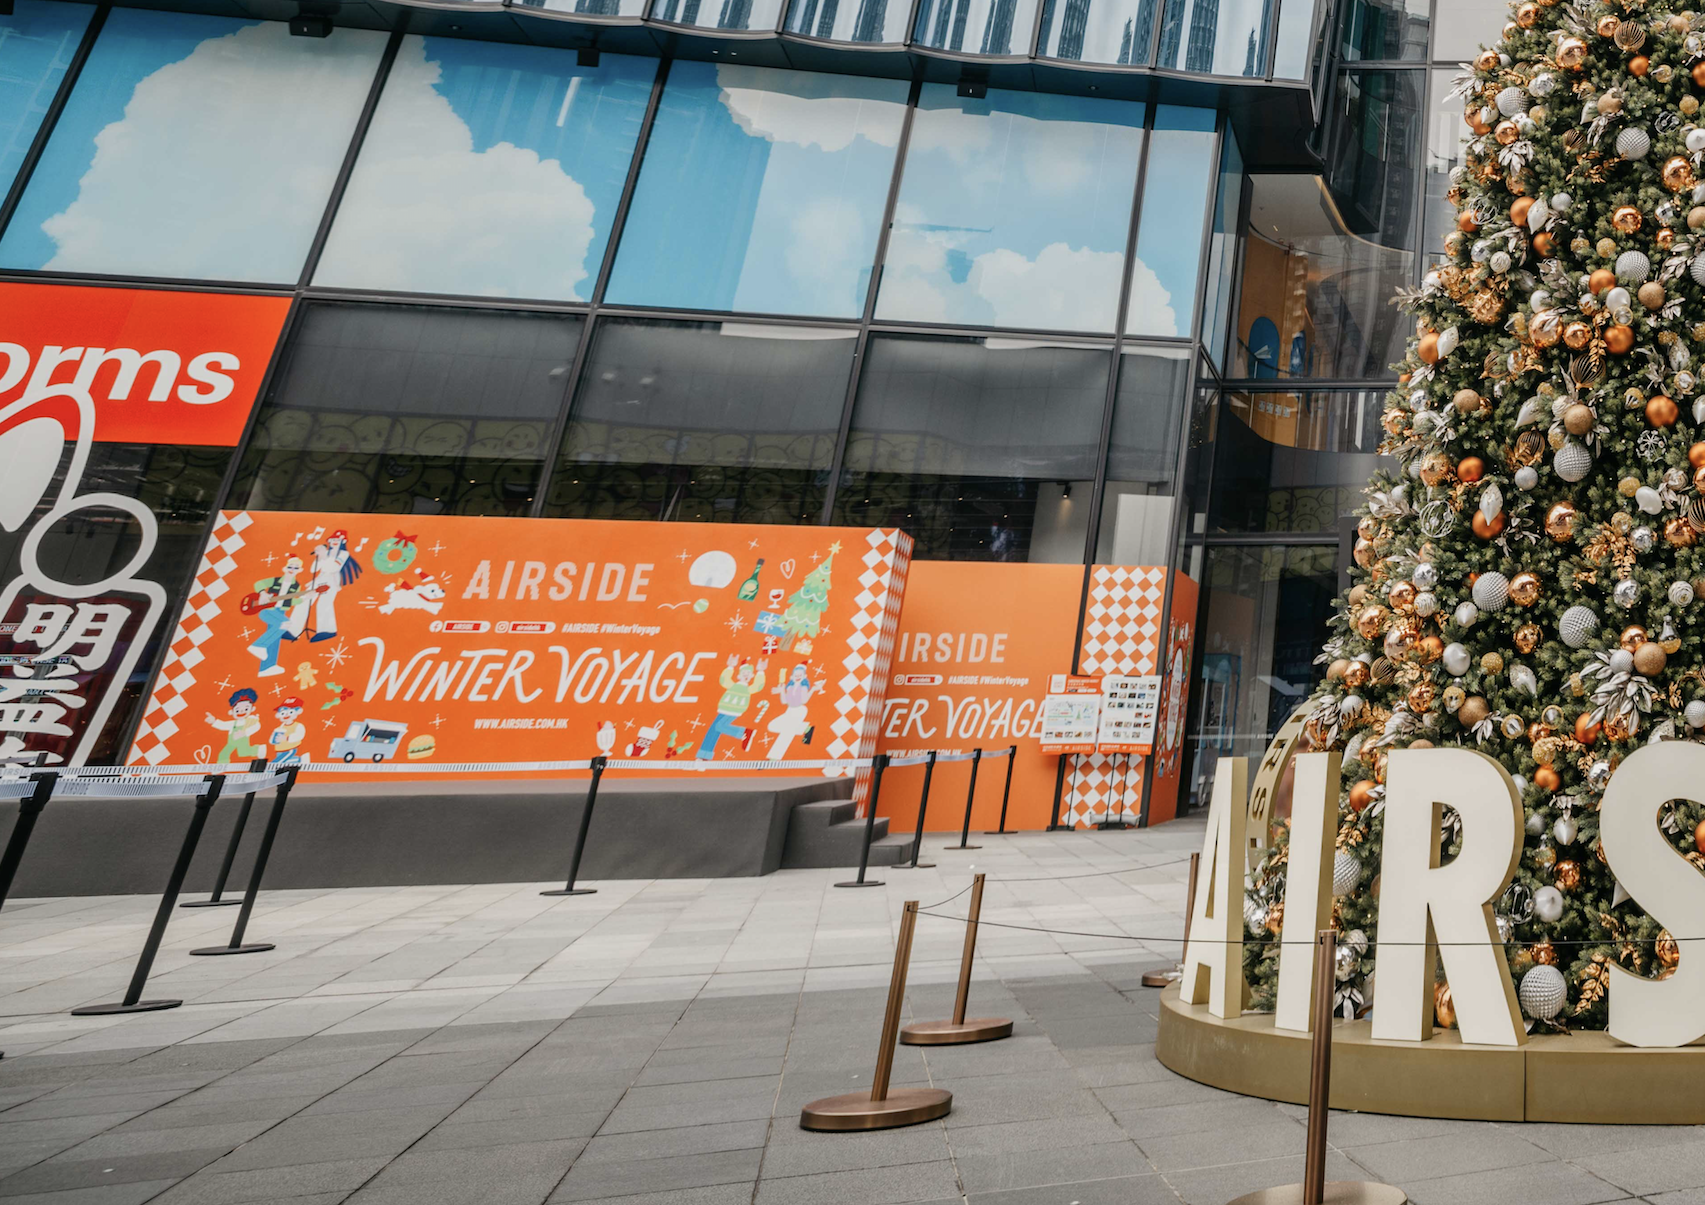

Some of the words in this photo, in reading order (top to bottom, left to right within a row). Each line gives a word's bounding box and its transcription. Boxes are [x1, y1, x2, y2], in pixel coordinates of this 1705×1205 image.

[462, 560, 654, 602] AIRSIDE
[562, 623, 600, 633] #AIRSIDE
[601, 624, 661, 636] #WinterVoyage
[358, 636, 543, 704] WINTER
[548, 646, 717, 705] VOYAGE
[948, 675, 978, 685] #AIRSIDE
[979, 675, 1029, 687] #WinterVoyage
[474, 718, 569, 729] WWW.AIRSIDE.COM.HK
